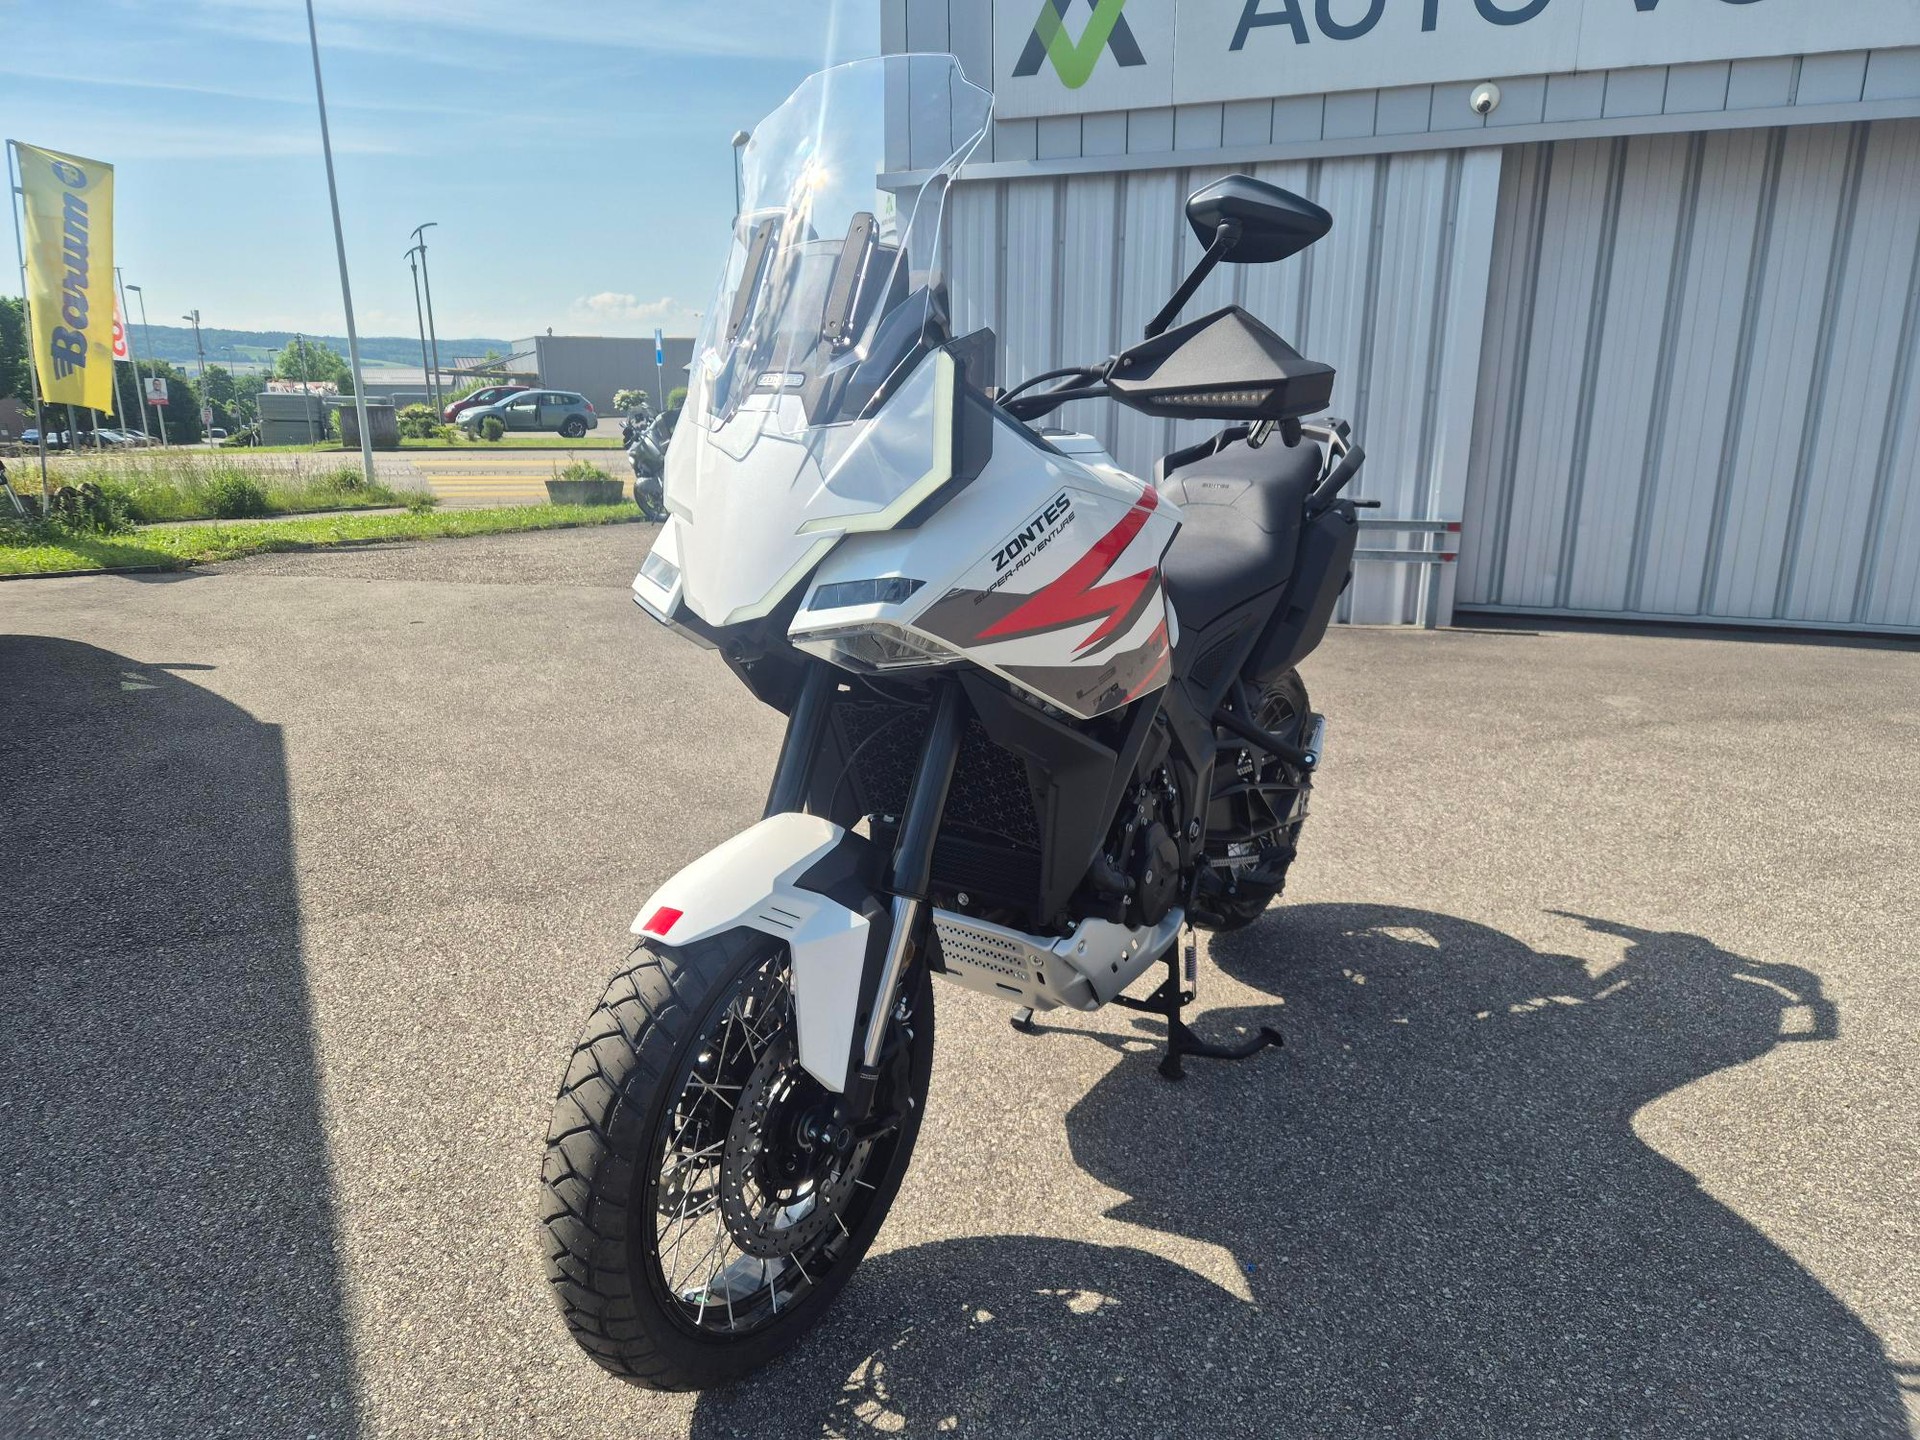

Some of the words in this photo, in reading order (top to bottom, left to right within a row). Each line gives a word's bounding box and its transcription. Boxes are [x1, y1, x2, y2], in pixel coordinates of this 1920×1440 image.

[51, 191, 89, 380] Barum
[974, 511, 1076, 606] SUPER-ADVENTURE
[991, 493, 1071, 572] ZONTES
